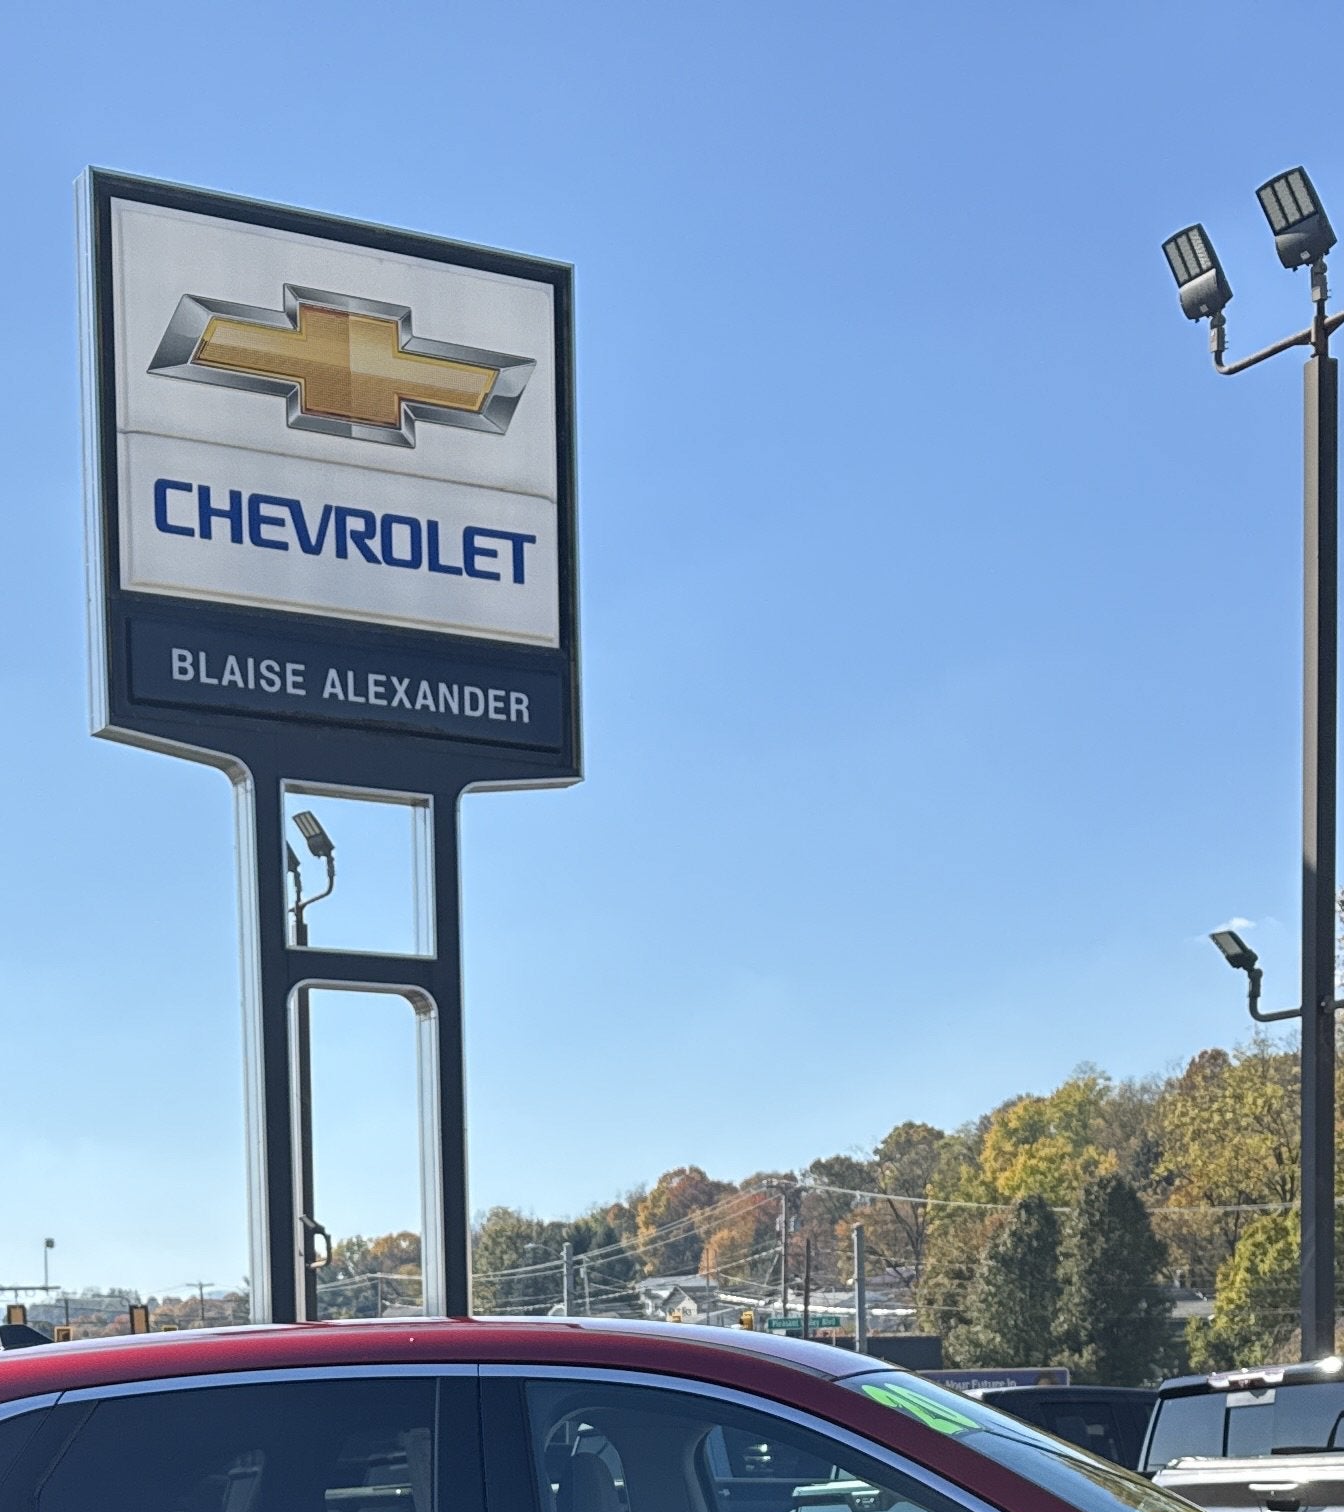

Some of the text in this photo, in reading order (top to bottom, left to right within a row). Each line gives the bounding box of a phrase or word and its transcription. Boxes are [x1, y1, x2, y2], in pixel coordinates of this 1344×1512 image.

[153, 477, 537, 585] CHEVROLET
[171, 646, 531, 725] BLAISE ALEXANDER
